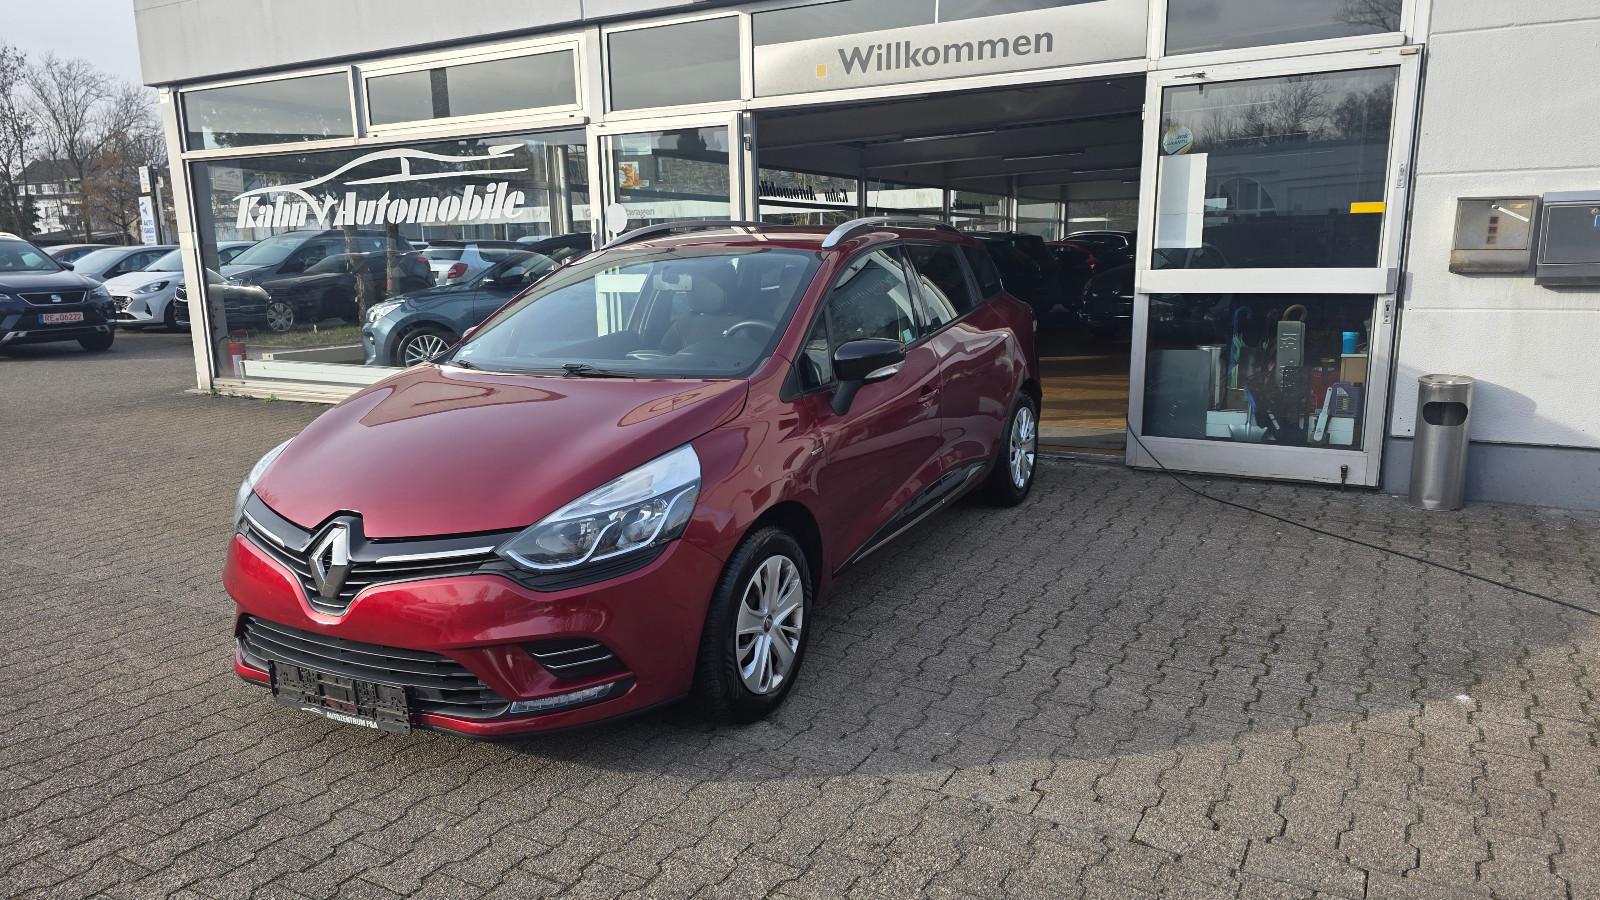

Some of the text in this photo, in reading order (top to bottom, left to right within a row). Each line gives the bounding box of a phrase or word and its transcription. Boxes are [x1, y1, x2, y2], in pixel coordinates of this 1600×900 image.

[838, 31, 1054, 75] Willkommen
[236, 181, 525, 229] Kahn Automobile
[326, 711, 366, 727] AUTOZENTRUM
